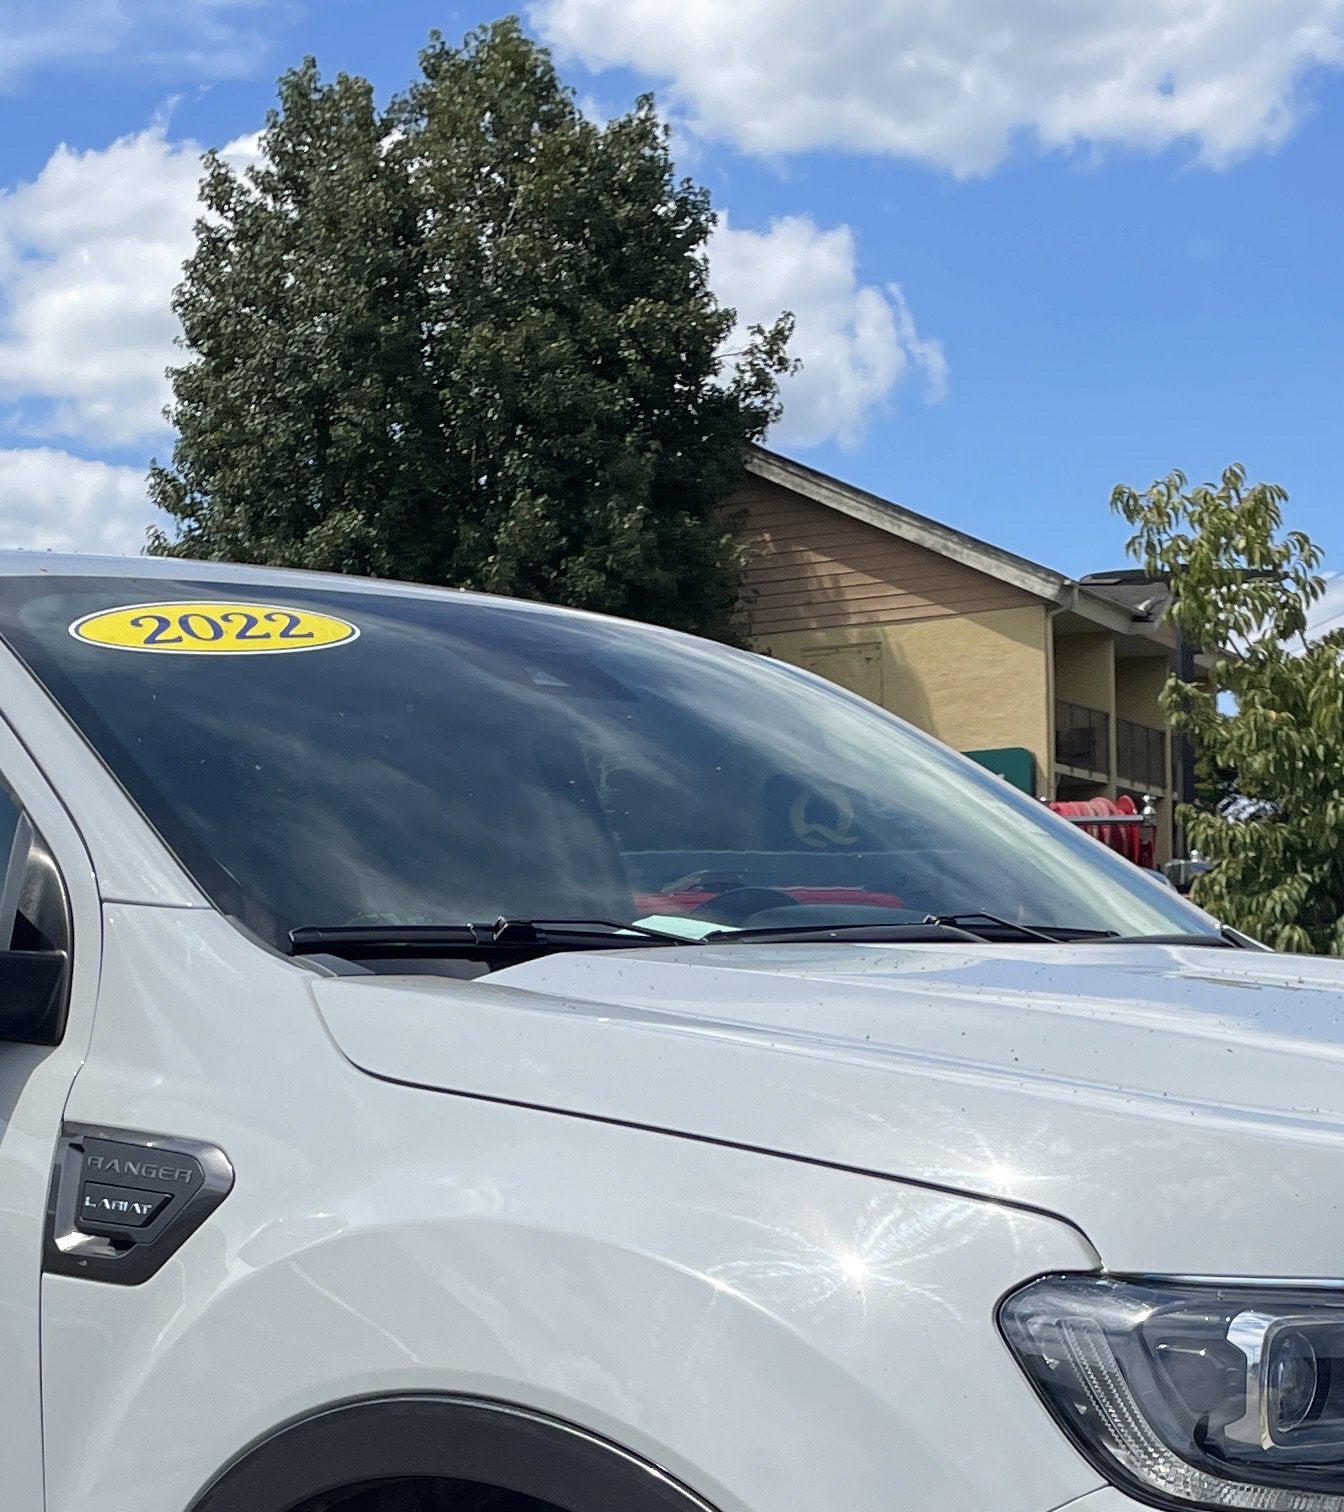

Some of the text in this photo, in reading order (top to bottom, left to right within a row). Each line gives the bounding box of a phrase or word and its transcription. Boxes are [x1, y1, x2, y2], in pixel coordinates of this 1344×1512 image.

[130, 611, 315, 645] 2022
[87, 1156, 193, 1184] RANGER
[85, 1196, 152, 1215] LARIAT
